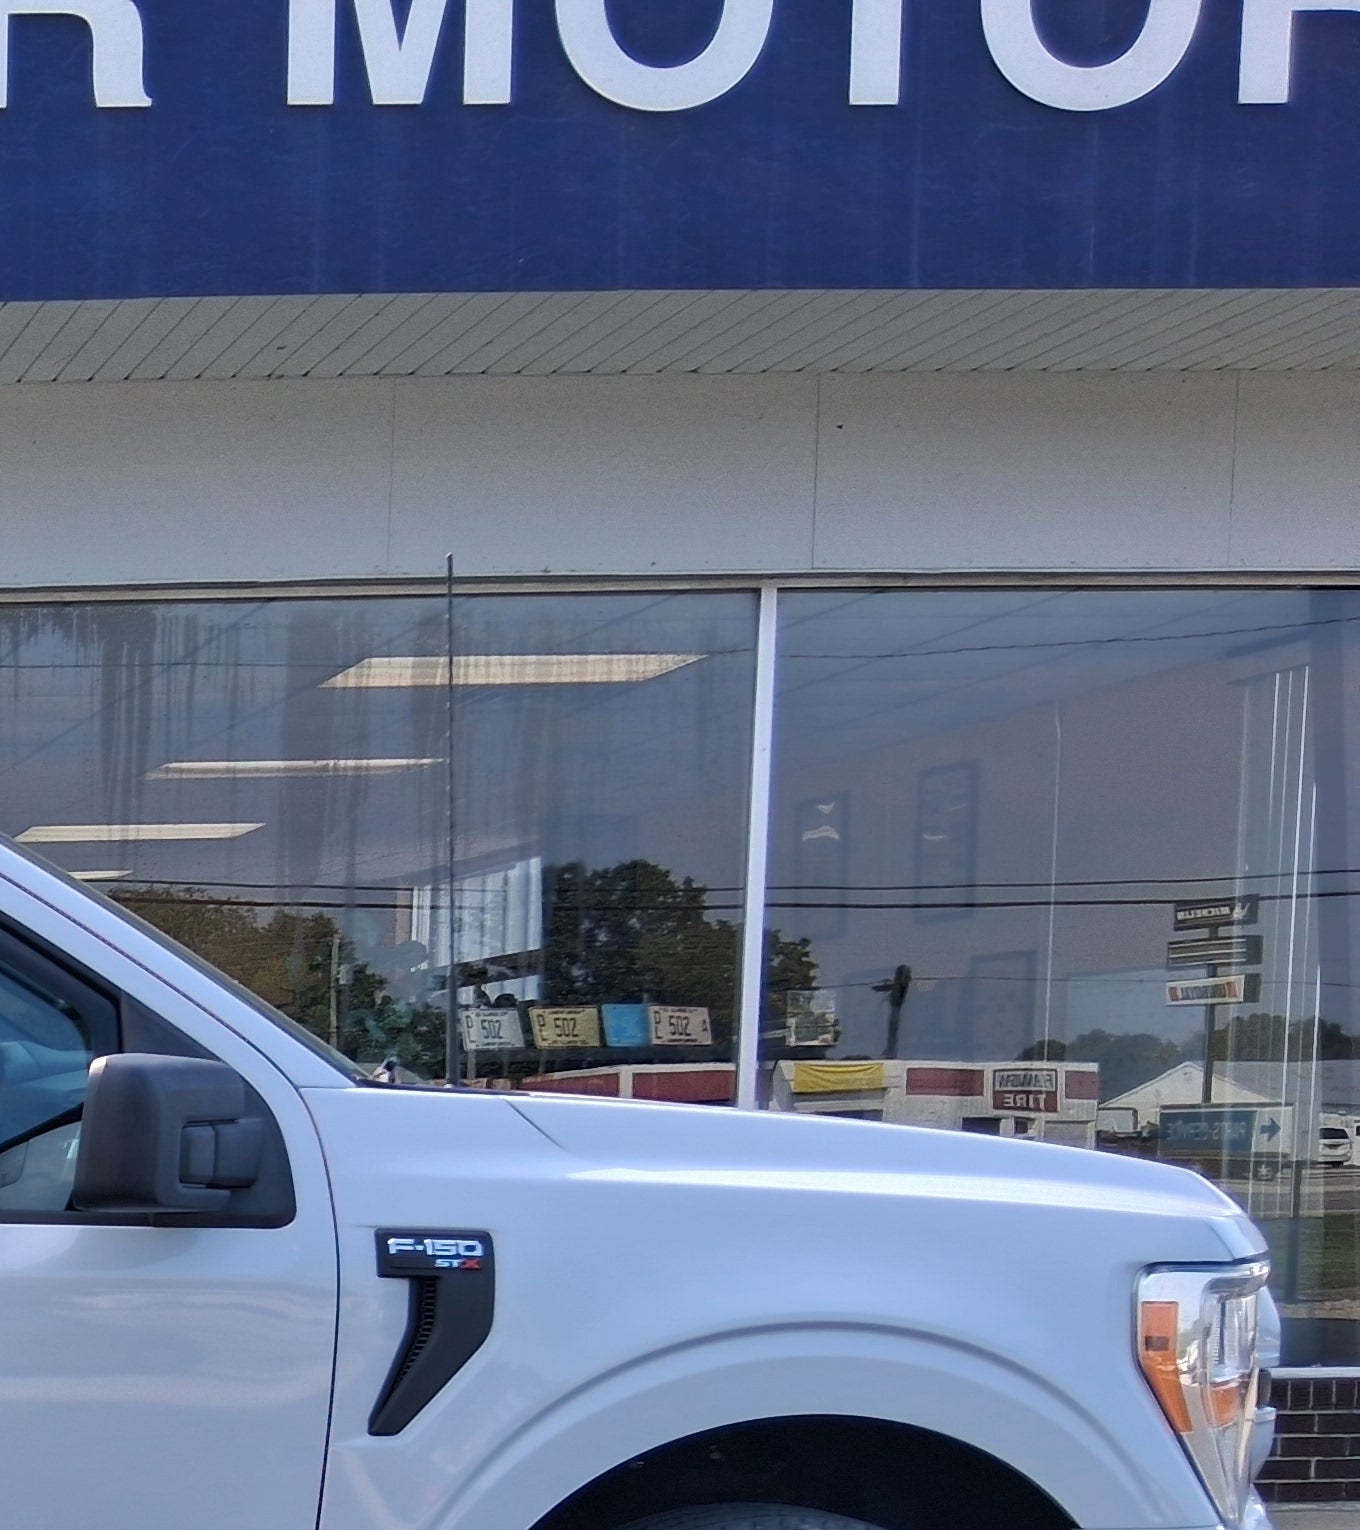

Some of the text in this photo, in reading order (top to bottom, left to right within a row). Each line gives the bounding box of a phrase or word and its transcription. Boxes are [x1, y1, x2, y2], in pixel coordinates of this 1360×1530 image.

[286, 0, 1360, 112] MOO
[480, 1018, 504, 1040] 502
[553, 1017, 579, 1038] 502
[668, 1015, 692, 1037] 502
[387, 1237, 484, 1256] F-150
[433, 1258, 482, 1270] STX
